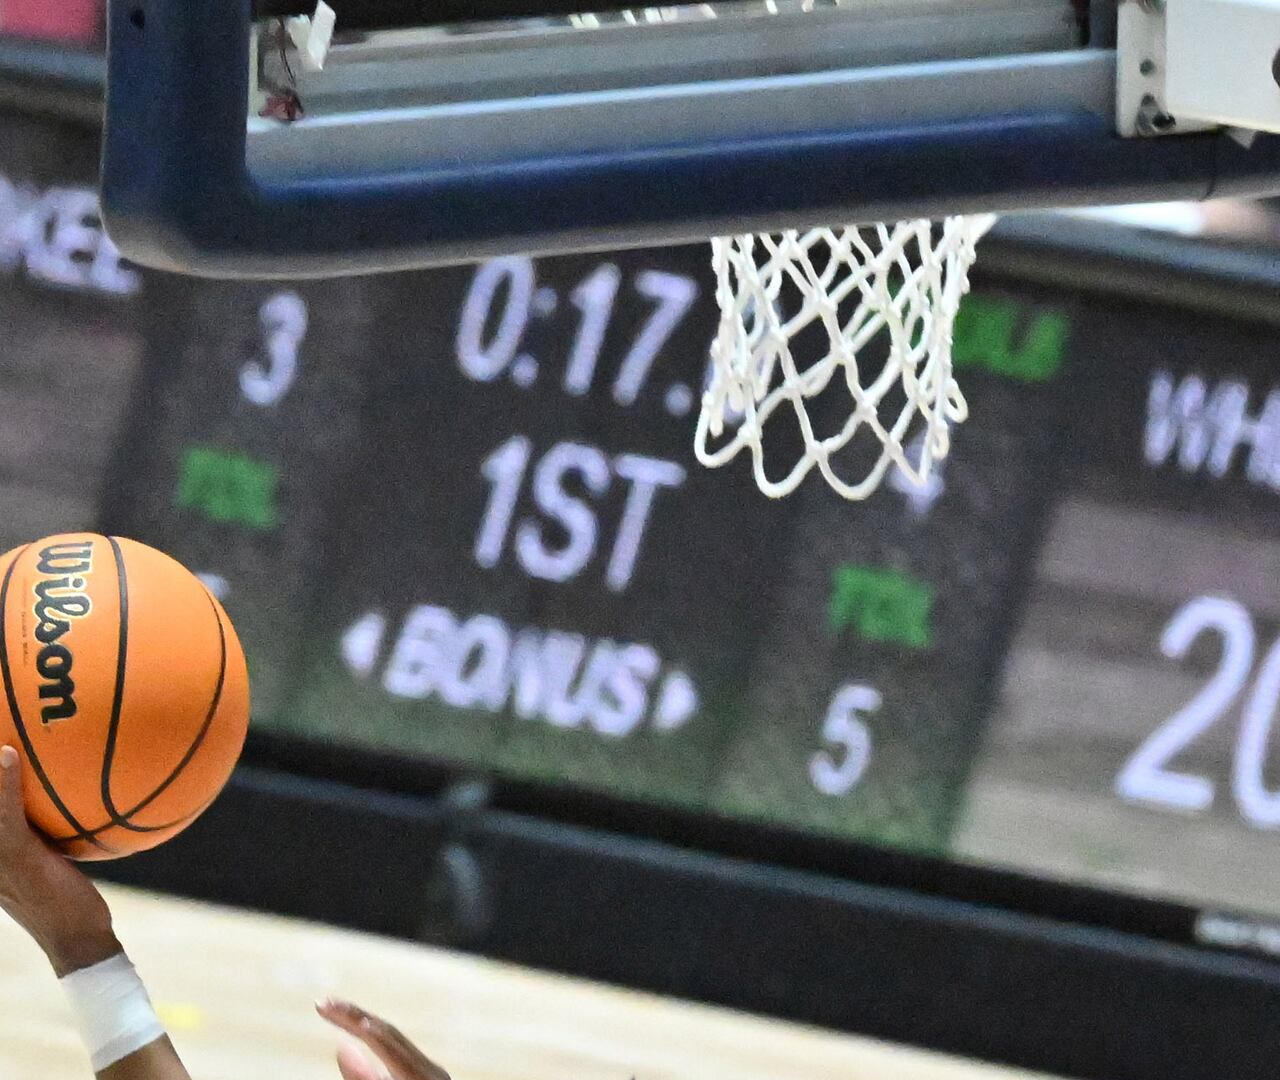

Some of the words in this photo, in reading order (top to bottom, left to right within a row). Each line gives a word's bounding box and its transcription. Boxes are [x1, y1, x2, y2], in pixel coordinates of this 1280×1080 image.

[238, 292, 308, 405] 3
[475, 434, 688, 590] 1ST
[32, 540, 96, 726] Wilson
[382, 603, 662, 738] BONUS
[809, 684, 883, 796] 5
